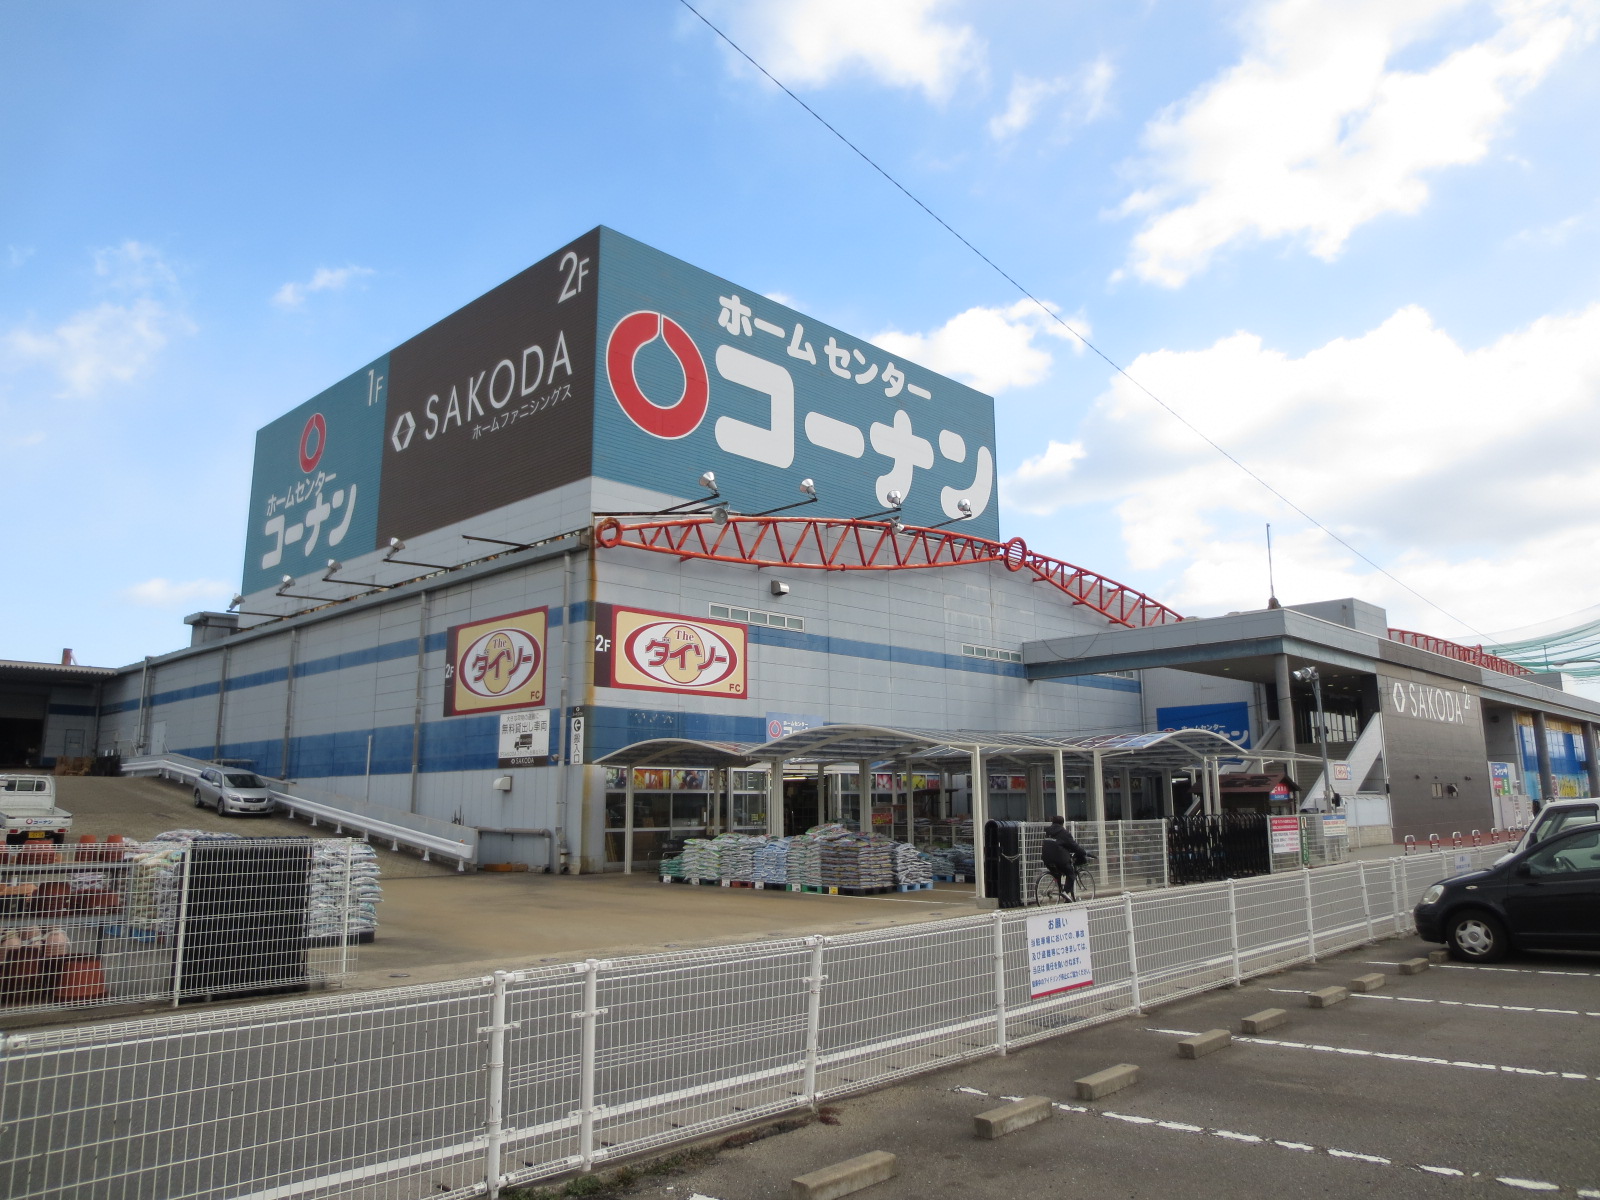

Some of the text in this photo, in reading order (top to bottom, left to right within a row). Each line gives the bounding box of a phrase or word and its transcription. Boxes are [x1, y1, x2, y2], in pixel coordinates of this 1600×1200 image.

[557, 251, 590, 304] 2F
[718, 294, 932, 400] ホームセンター
[368, 369, 384, 406] 1F
[424, 330, 573, 440] SAKODA
[472, 384, 572, 440] ホームファニシングス
[714, 344, 993, 520] コーナン
[267, 470, 336, 516] ホームセンター
[262, 484, 357, 570] コーナン
[493, 638, 507, 649] The
[595, 635, 611, 652] 2F
[645, 637, 727, 672] ダイソー
[675, 630, 694, 642] The
[445, 664, 454, 678] 2F
[472, 645, 532, 683] ダイソー
[531, 690, 540, 700] FC
[729, 683, 741, 692] FC
[1409, 683, 1471, 724] SAKODA 2F
[502, 721, 547, 735] 無料貸出し車両
[1048, 917, 1068, 930] お願い
